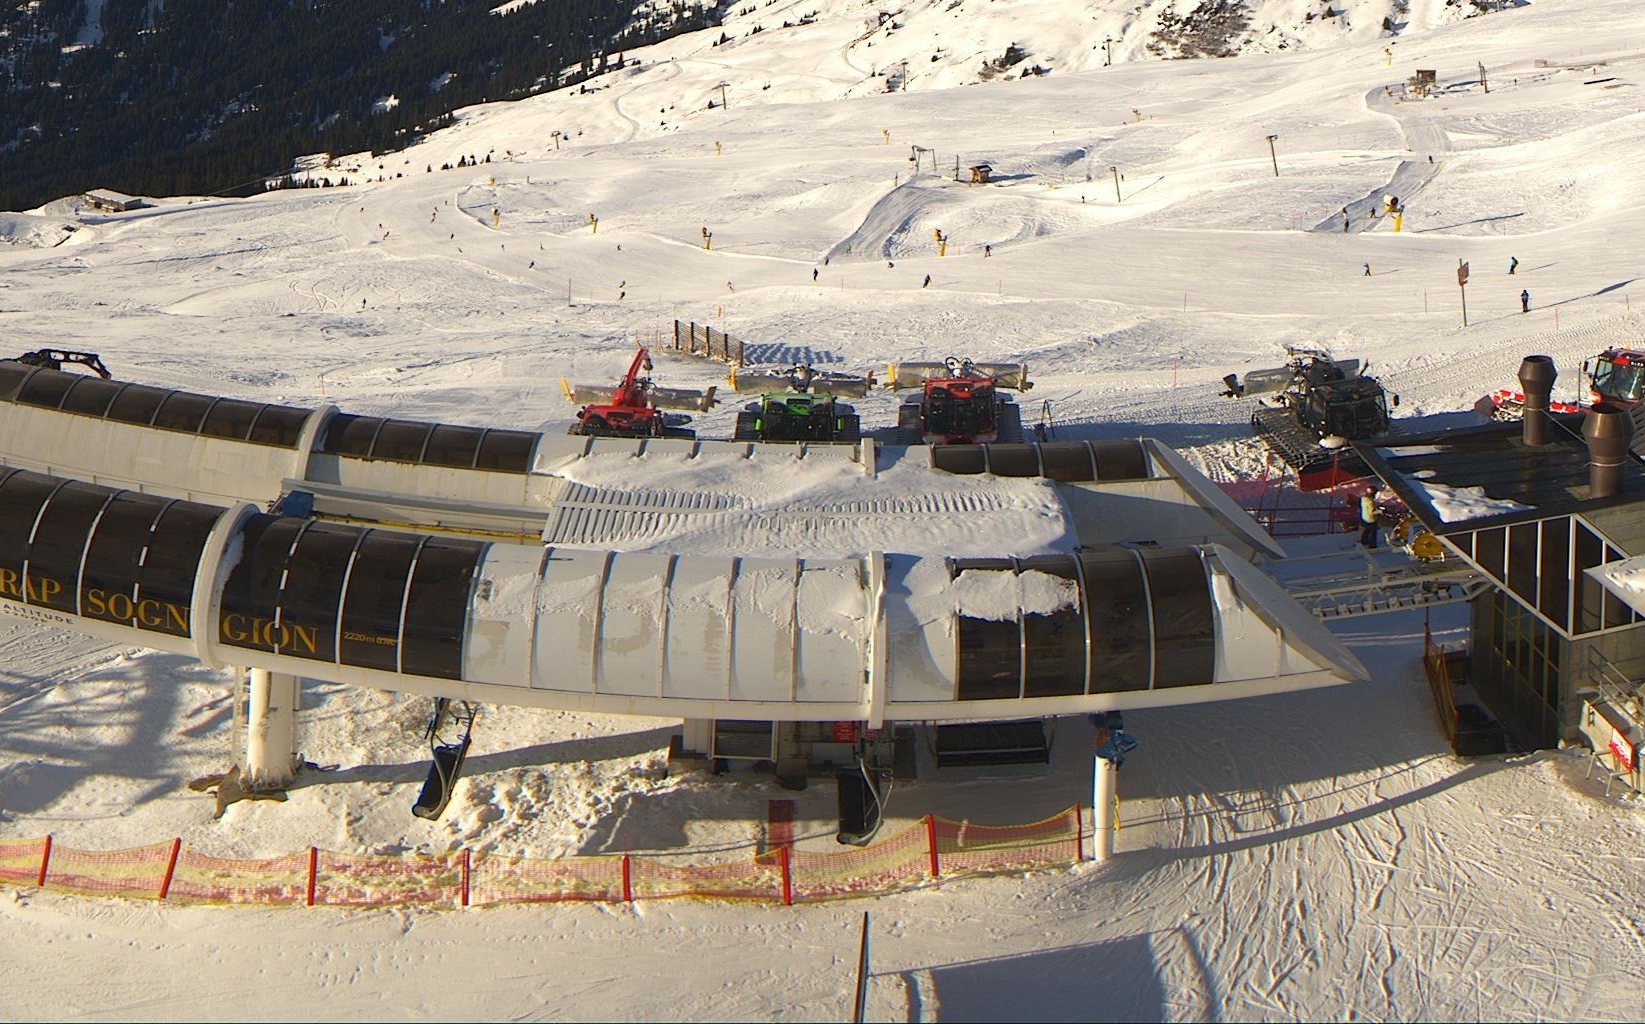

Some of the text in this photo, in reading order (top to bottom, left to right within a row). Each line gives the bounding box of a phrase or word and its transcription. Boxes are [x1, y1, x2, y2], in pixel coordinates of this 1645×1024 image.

[3, 603, 75, 625] ALTITUDE
[87, 587, 191, 633] SOGN
[223, 612, 320, 655] GION
